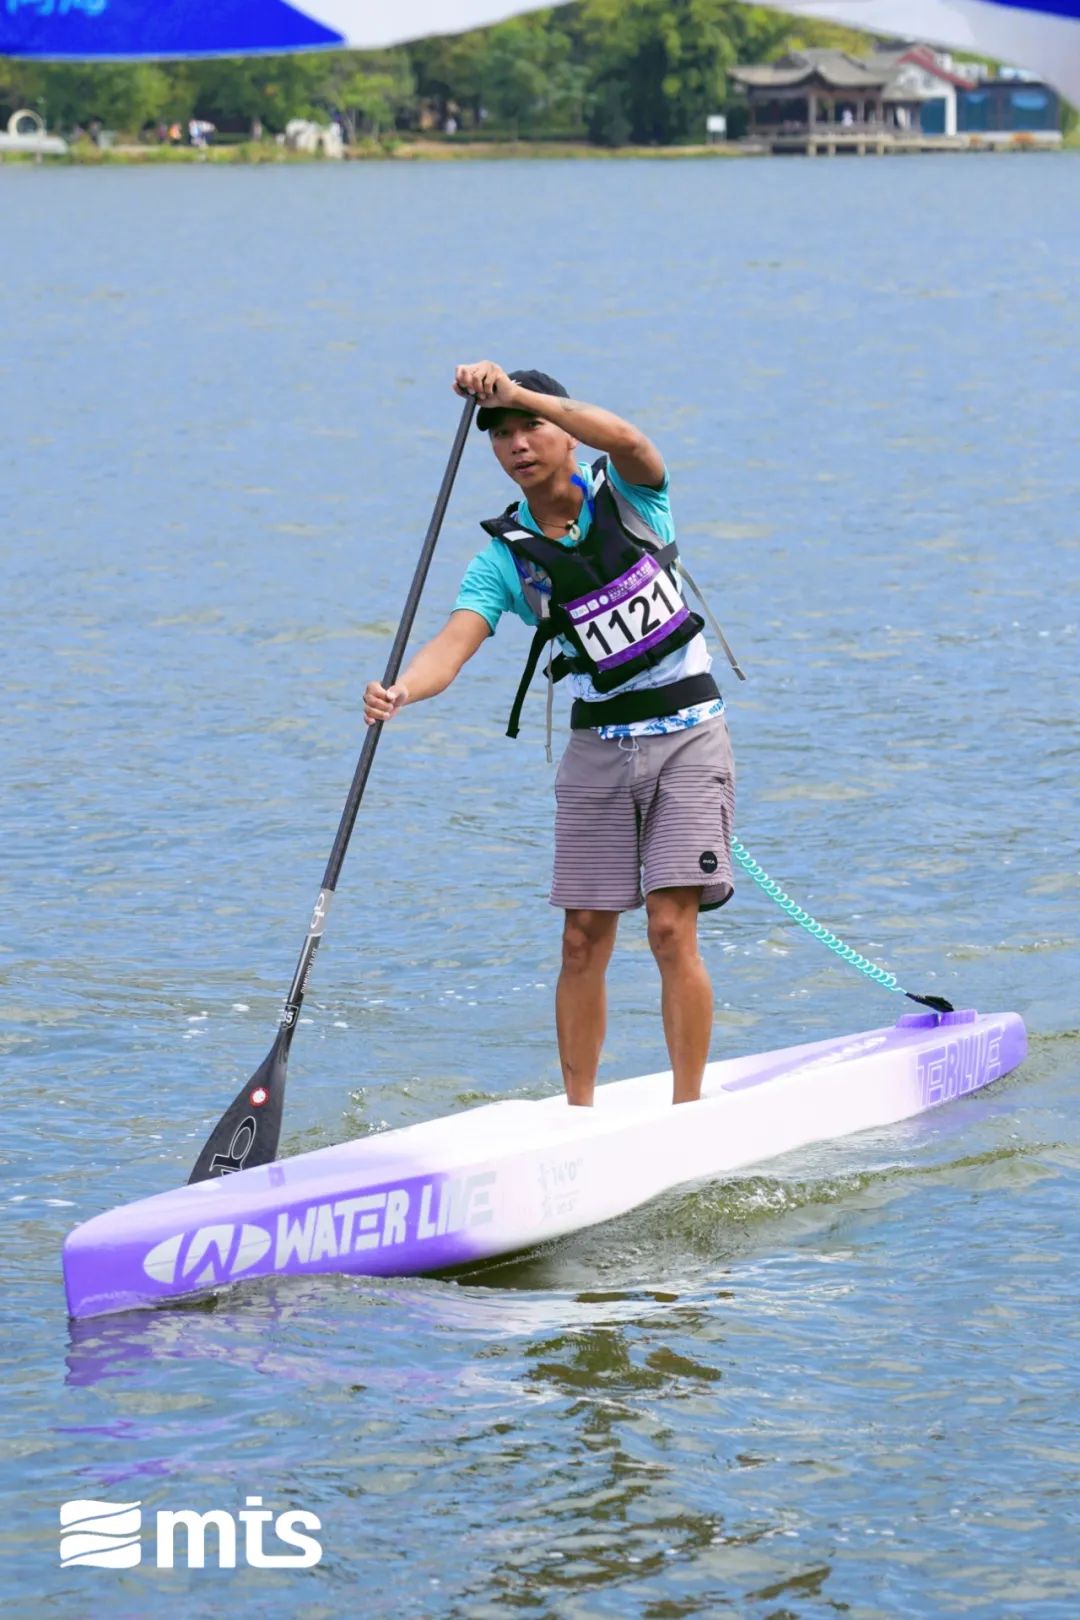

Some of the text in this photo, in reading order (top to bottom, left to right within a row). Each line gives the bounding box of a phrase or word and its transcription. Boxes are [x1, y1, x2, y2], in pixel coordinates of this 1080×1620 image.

[586, 581, 675, 656] 1121
[274, 1171, 497, 1270] WATER LINE
